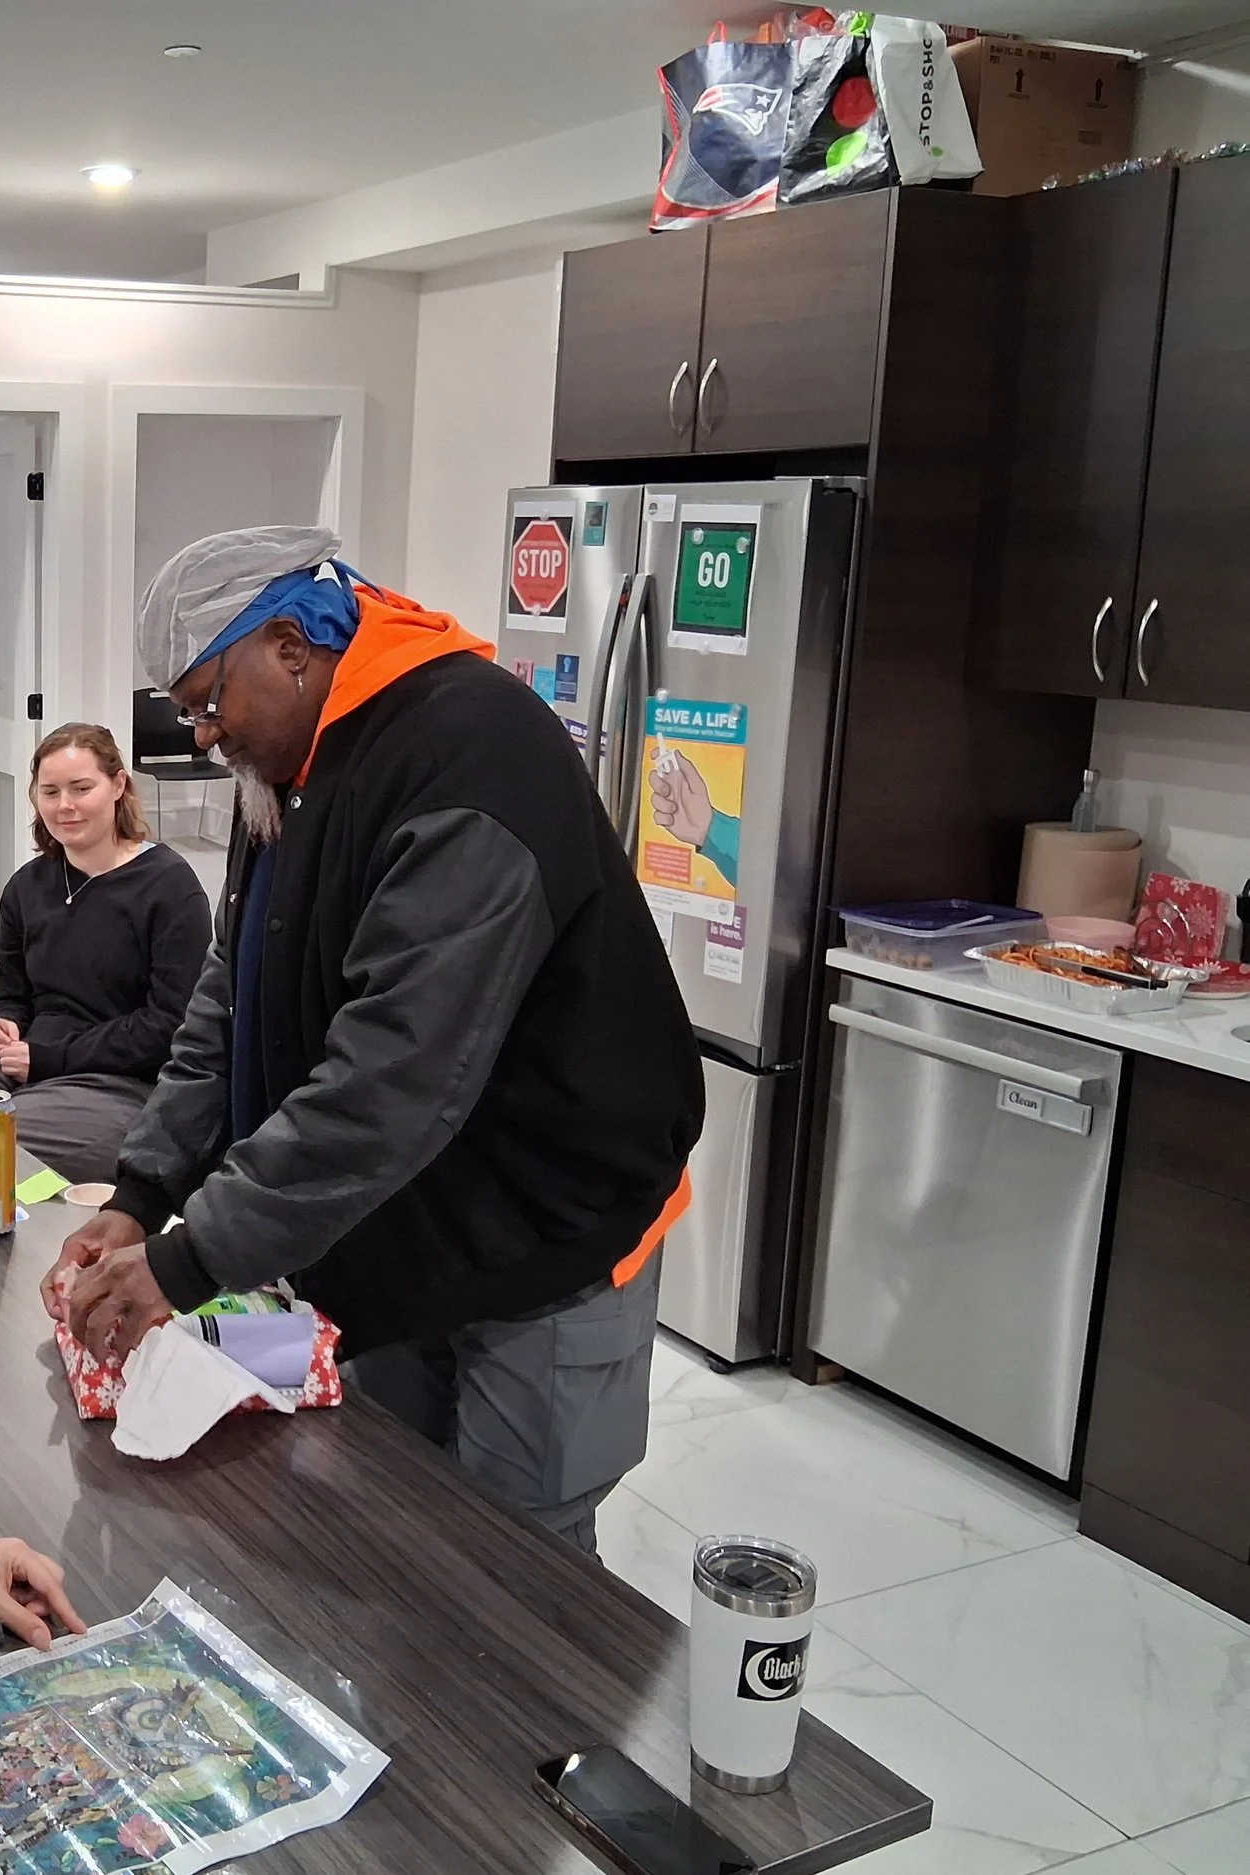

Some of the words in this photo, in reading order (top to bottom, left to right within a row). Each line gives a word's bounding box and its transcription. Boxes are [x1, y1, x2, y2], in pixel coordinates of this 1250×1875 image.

[517, 549, 562, 578] STOP
[698, 551, 730, 588] GO
[654, 708, 690, 724] SAVE
[692, 711, 702, 726] A
[706, 712, 737, 729] LIFE
[1009, 1091, 1038, 1110] Clean
